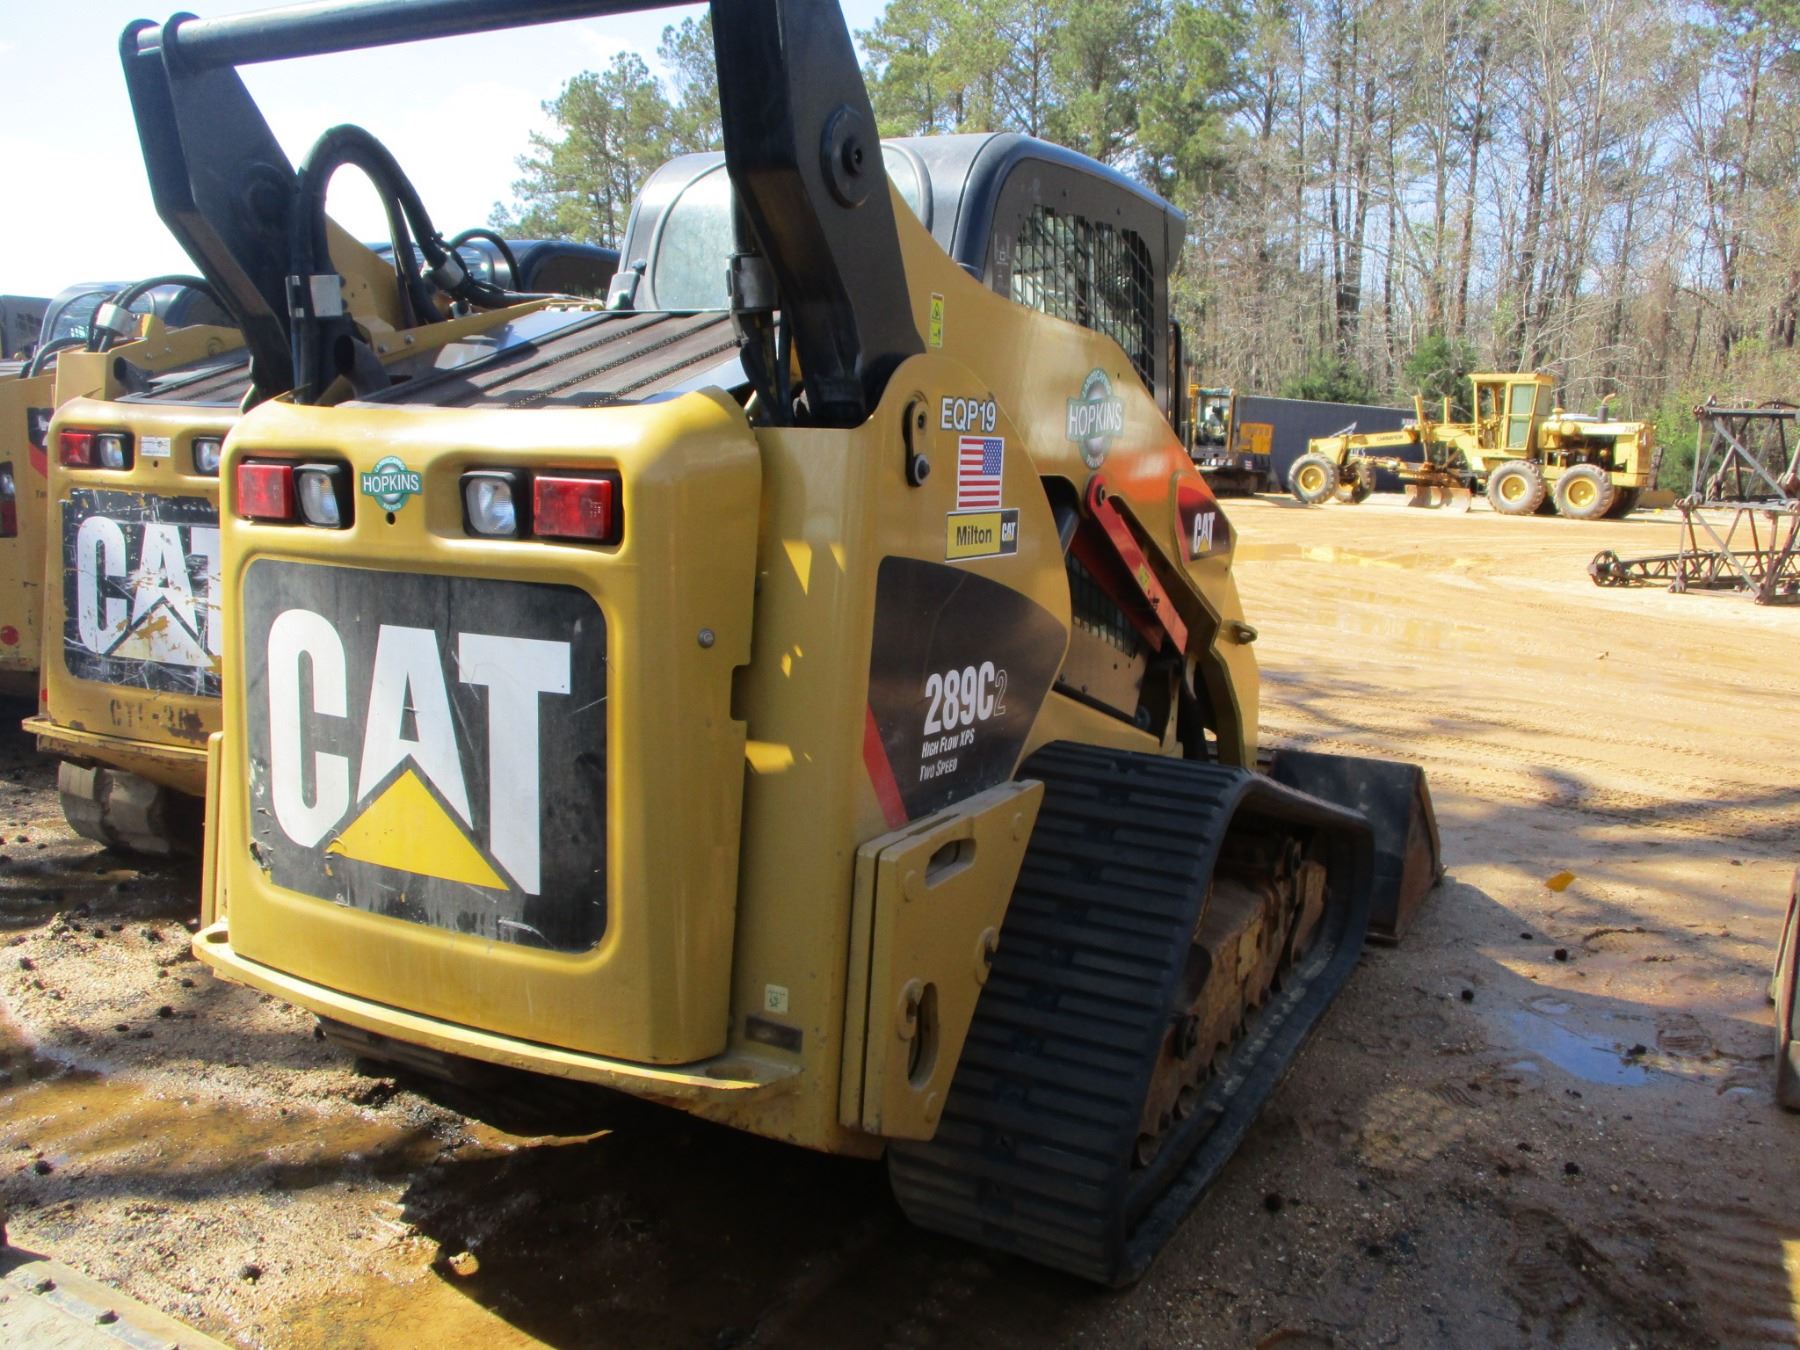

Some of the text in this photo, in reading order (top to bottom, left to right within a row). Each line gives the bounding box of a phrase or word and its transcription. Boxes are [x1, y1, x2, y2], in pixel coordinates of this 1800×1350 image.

[940, 396, 997, 432] EQP19
[1069, 401, 1122, 436] HOPKINS
[363, 473, 419, 493] HOPKINS
[956, 526, 993, 548] Milton
[1001, 521, 1016, 542] CAT
[1193, 511, 1216, 554] CAT
[923, 661, 1008, 736] 289C2
[267, 608, 572, 896] CAT
[921, 728, 976, 759] HIGH FLOW XPS
[919, 758, 958, 782] TWO SPEED
